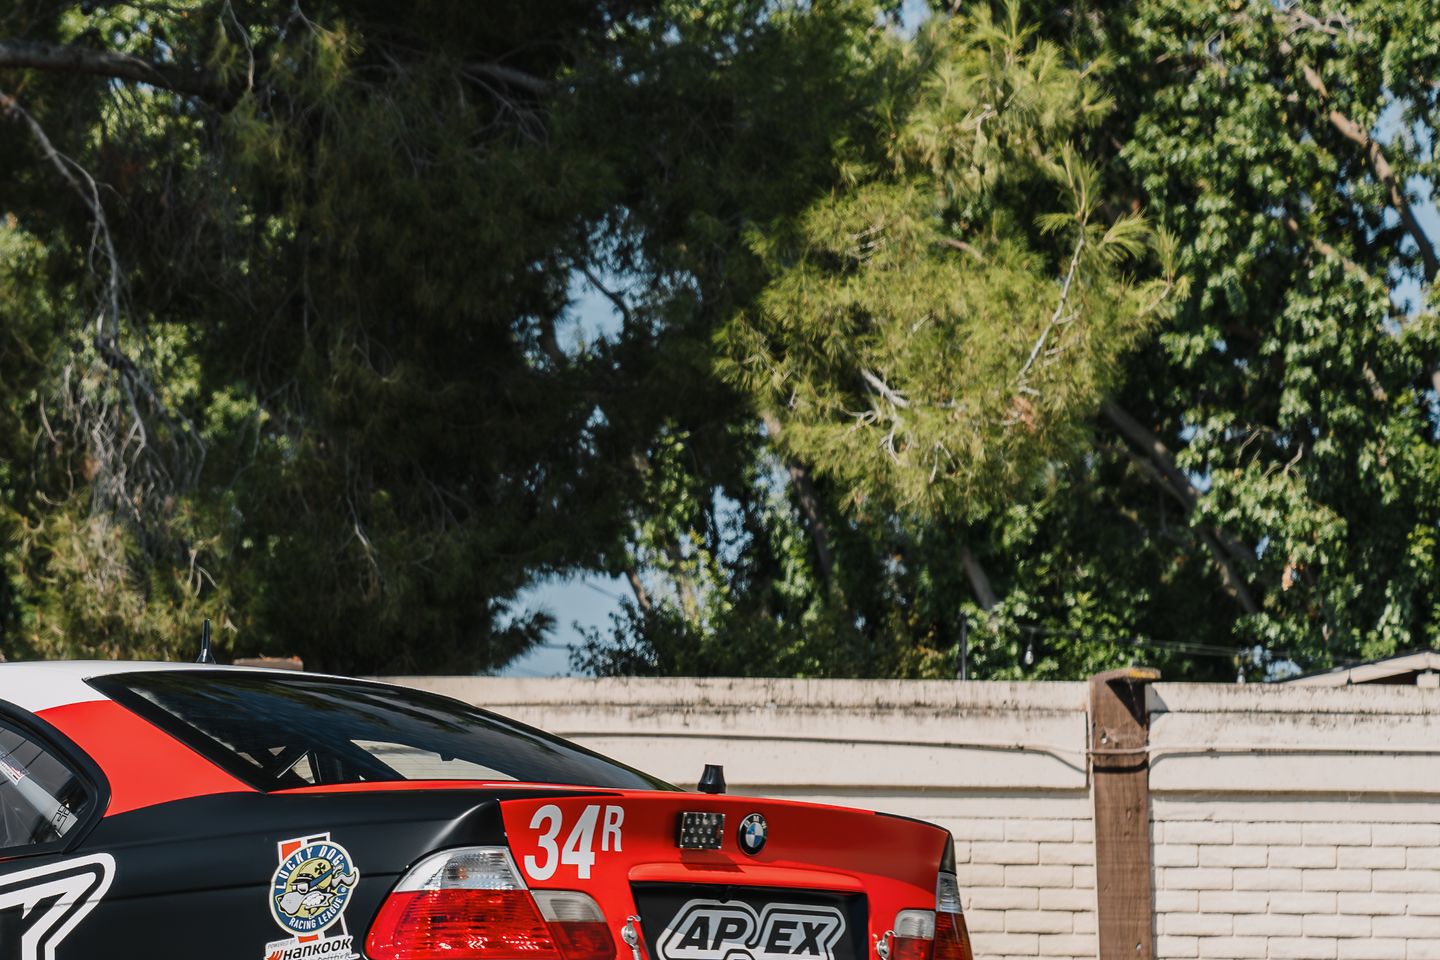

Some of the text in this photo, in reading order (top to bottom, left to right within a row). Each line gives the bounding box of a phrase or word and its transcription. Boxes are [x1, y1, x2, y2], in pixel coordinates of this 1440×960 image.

[524, 804, 624, 881] 34 R
[276, 846, 344, 889] LUCKY DOG
[289, 897, 344, 930] RACING LEAGUE
[674, 916, 829, 956] APEX
